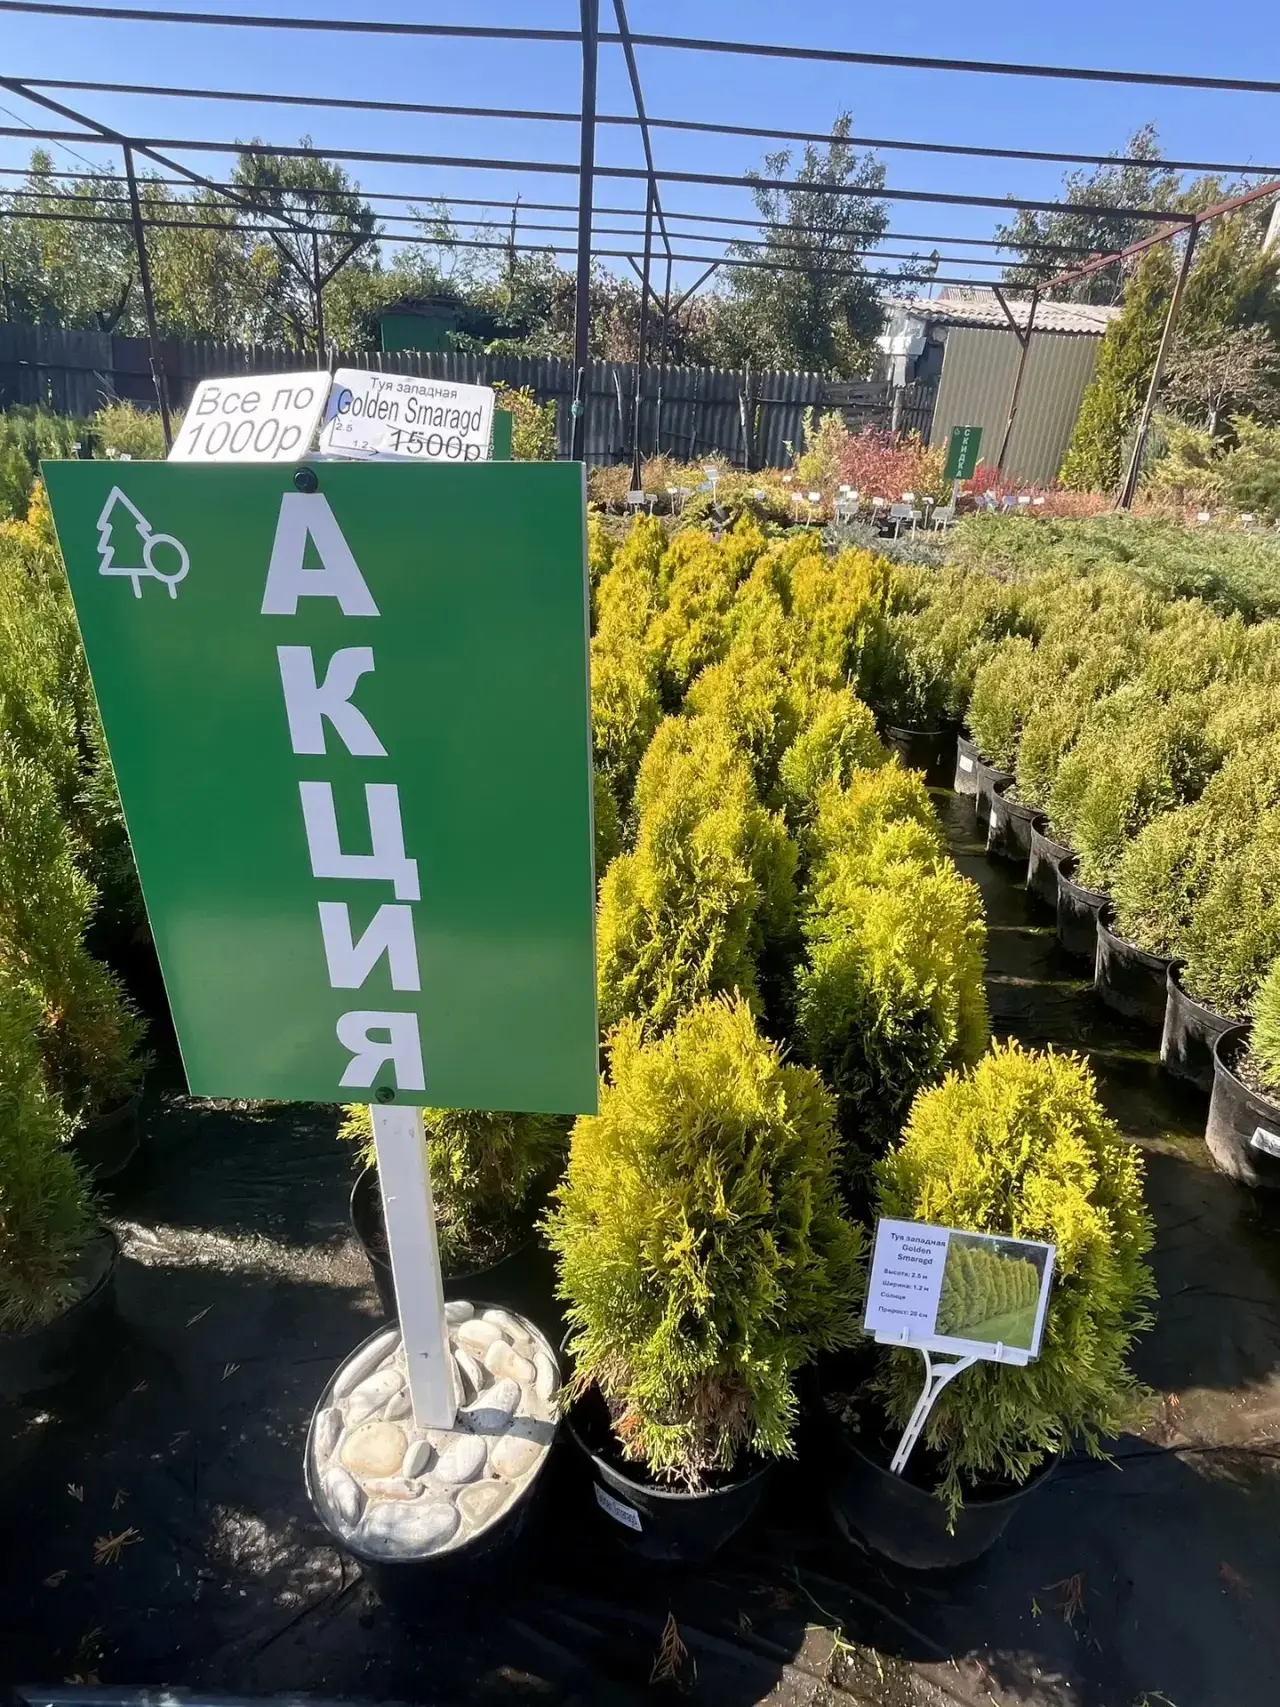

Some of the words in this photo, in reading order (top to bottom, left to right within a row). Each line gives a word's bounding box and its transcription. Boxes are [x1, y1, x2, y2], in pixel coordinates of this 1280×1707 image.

[371, 378, 393, 391] Туя
[397, 384, 458, 399] западная
[196, 387, 261, 416] Все
[272, 387, 314, 411] по
[338, 388, 399, 422] Golden
[405, 397, 482, 437] Smaragd
[336, 422, 353, 432] 2.5
[188, 418, 301, 459] 1000р
[353, 440, 368, 449] 1.2
[956, 429, 971, 477] СКИДКА
[260, 492, 426, 1091] АКЦИЯ
[891, 1232, 904, 1241] Туя
[906, 1236, 946, 1246] западная
[902, 1244, 931, 1254] Golden
[897, 1253, 933, 1265] Smaragd
[884, 1268, 910, 1278] Высота:
[882, 1280, 911, 1289] Ширина:
[880, 1292, 906, 1300] Солнце
[878, 1306, 908, 1315] Прирост:
